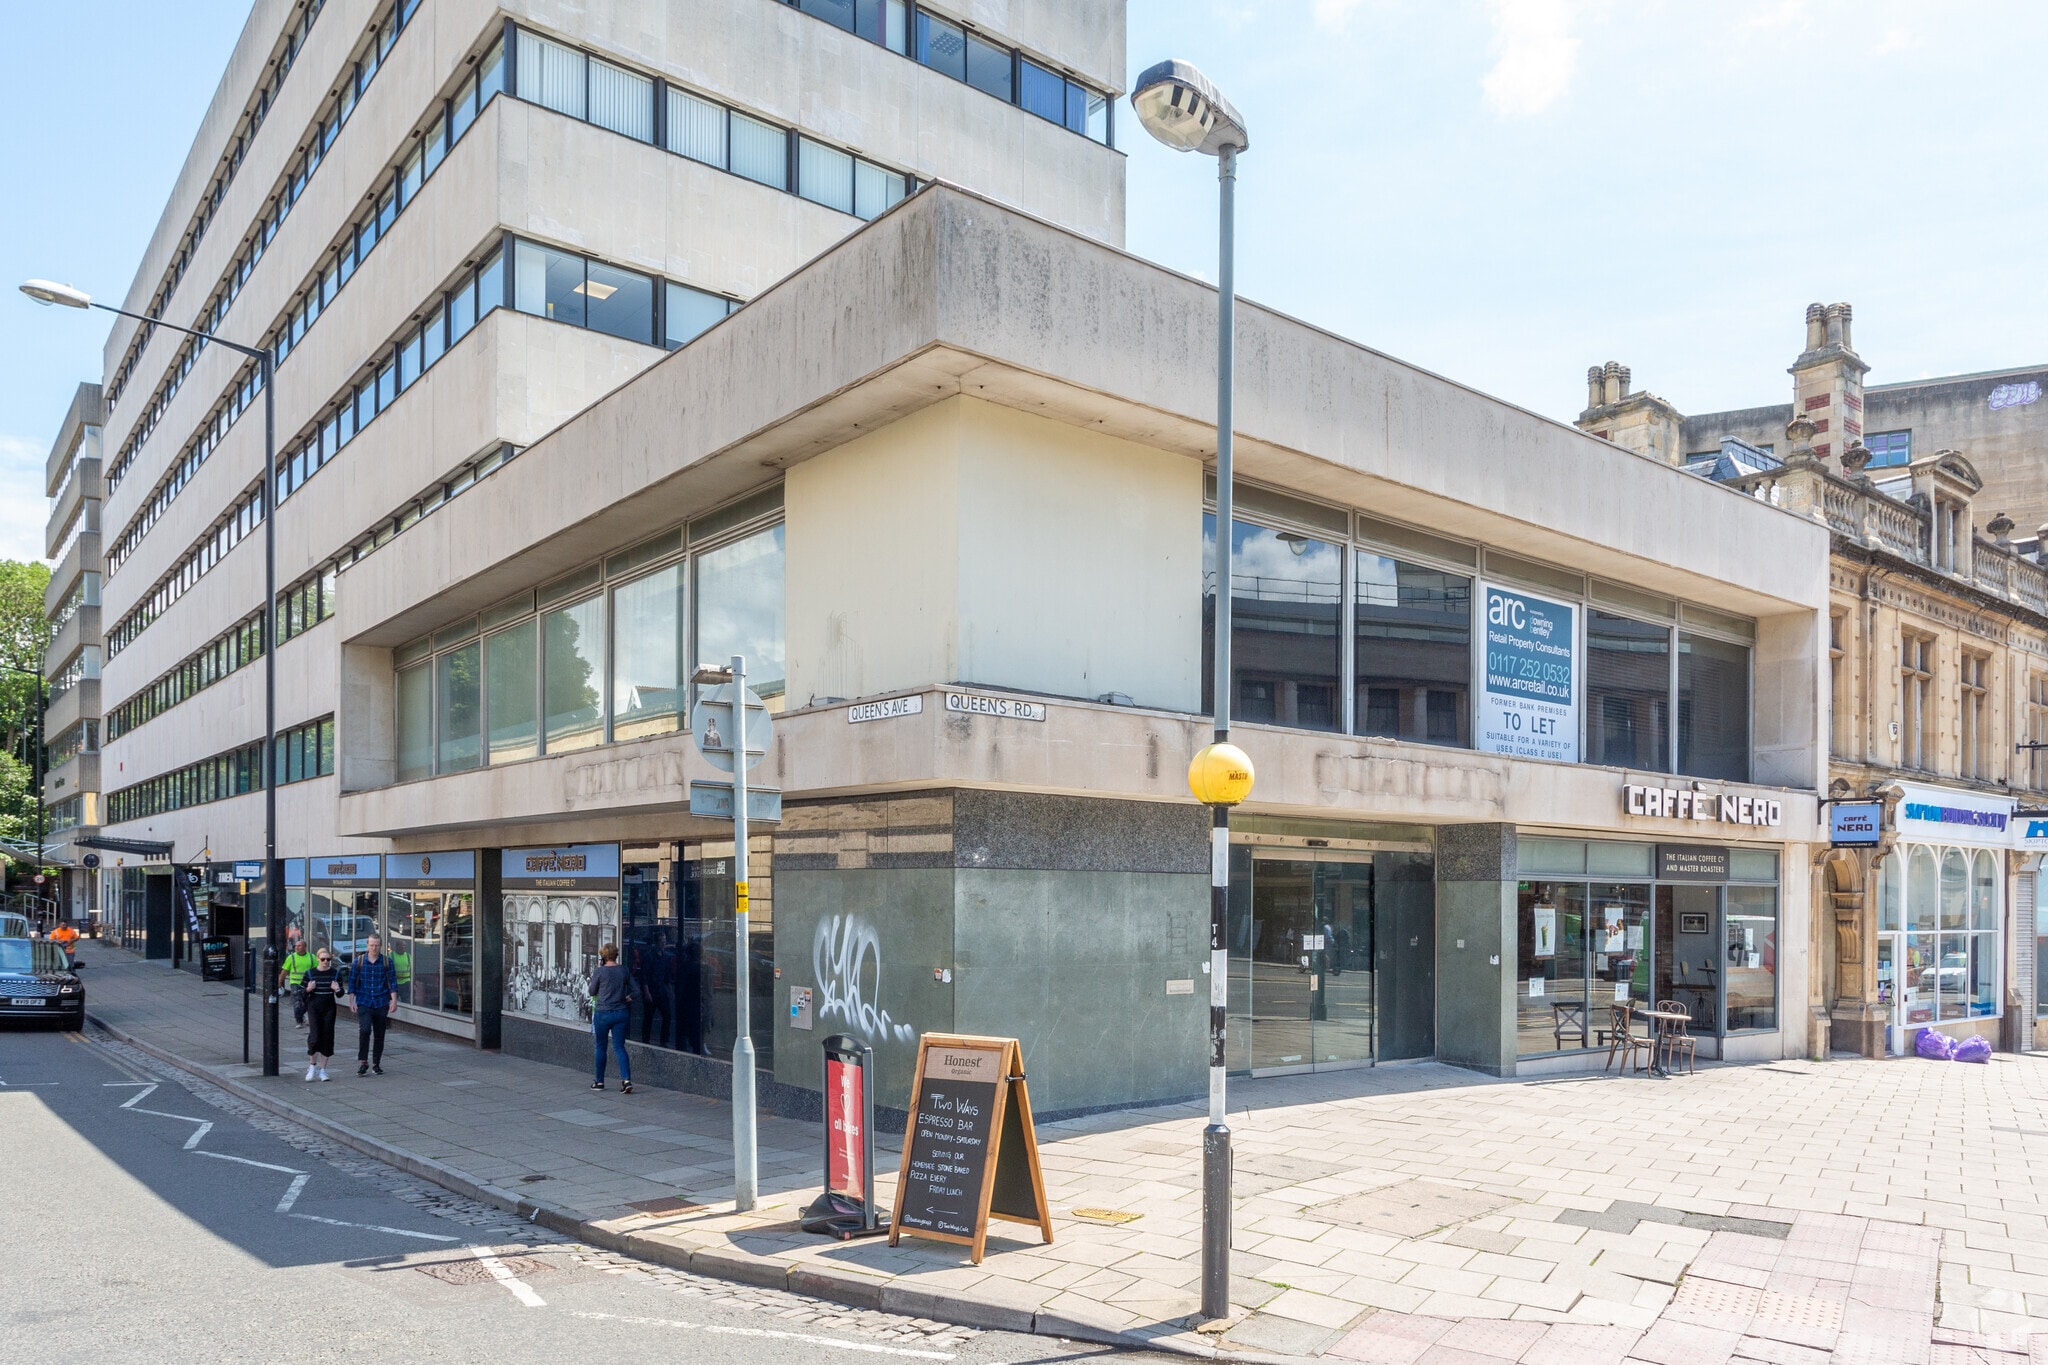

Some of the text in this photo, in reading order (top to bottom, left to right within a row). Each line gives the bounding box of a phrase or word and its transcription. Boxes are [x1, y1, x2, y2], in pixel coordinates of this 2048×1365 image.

[1488, 594, 1526, 630] arc
[1530, 615, 1553, 631] downing
[1530, 624, 1550, 639] bentley
[1489, 630, 1570, 658] Retail Property Consultants
[1489, 651, 1570, 685] 0117 252 0532
[1488, 673, 1570, 699] www.arcretail.co.uk
[851, 700, 889, 720] QUEEN'S
[951, 694, 1007, 715] QUEEN'S
[1490, 697, 1567, 717] FORMER BANK PREMISES
[1503, 712, 1556, 736] TO LET
[1486, 731, 1514, 743] SUITABLE
[1517, 735, 1530, 744] FOR
[1538, 738, 1562, 749] VARIETY
[1563, 742, 1571, 750] OF
[1496, 743, 1513, 754] USES
[1516, 746, 1538, 757] (CLASS
[1547, 750, 1562, 760] USE)
[1624, 780, 1782, 827] CAFFÈ NERO
[1837, 823, 1873, 832] NERO
[1666, 853, 1676, 861] THE
[1677, 853, 1697, 862] ITALIAN
[1698, 854, 1716, 863] COFFEE
[1666, 864, 1724, 873] AND MASTER ROASTERS
[556, 879, 570, 887] COFFEE
[944, 1054, 982, 1068] Honest
[840, 1075, 851, 1088] We
[834, 1118, 842, 1131] all
[918, 1113, 974, 1131] ESPRESSO BAR
[921, 1129, 933, 1138] OPEN
[931, 1149, 965, 1160] SERVING OUR
[911, 1160, 970, 1175] HOMEMADE STONE BAKED
[910, 1169, 947, 1184] PIZZA EVERY
[928, 1184, 963, 1197] FRIDAY LUNCH
